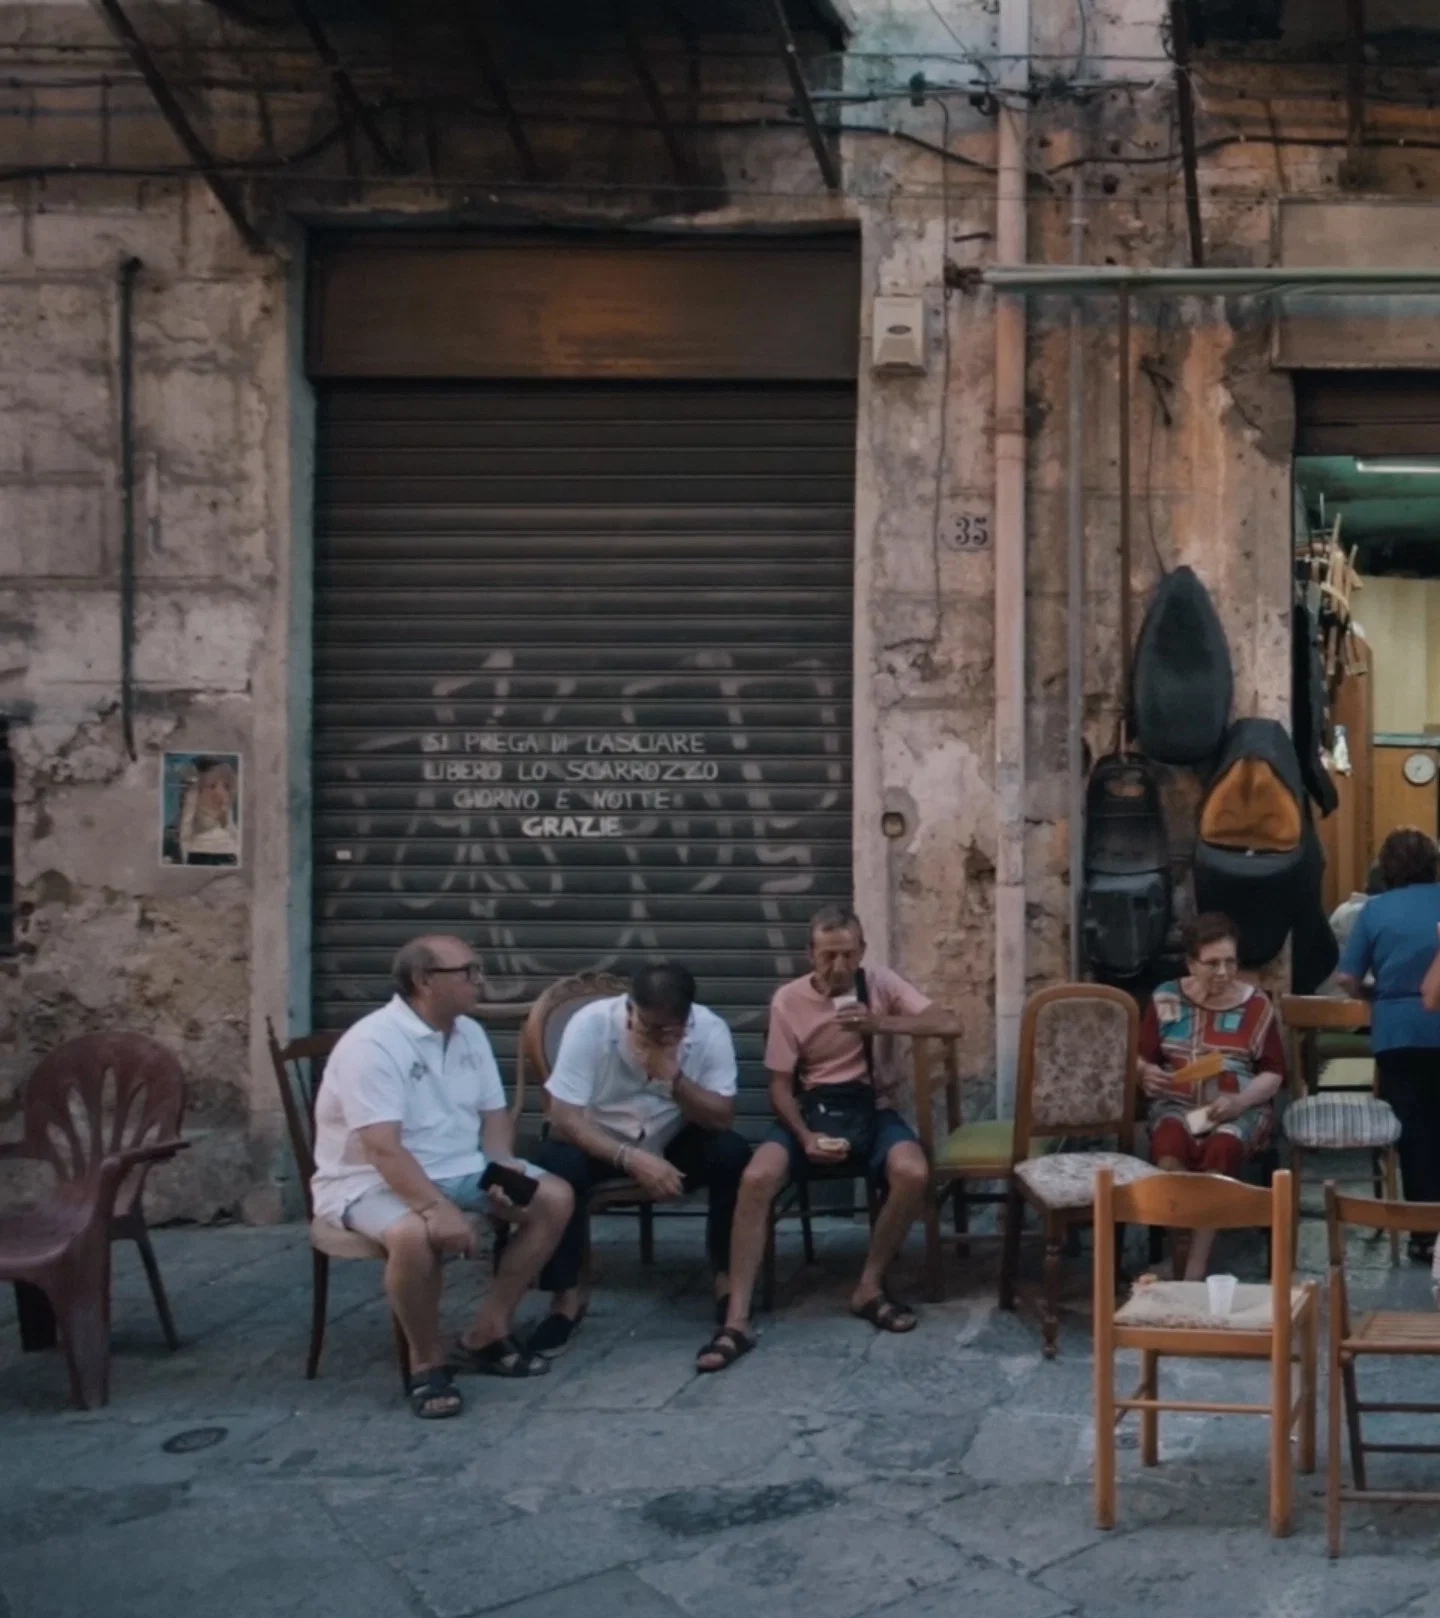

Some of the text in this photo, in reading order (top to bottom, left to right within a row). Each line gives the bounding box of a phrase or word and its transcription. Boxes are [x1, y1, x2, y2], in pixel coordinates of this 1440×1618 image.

[955, 516, 988, 545] 35
[421, 732, 706, 752] SI PREGA DI LASCIARE
[422, 760, 719, 780] LIBERO LO SCARROZZO
[452, 788, 670, 809] GIORNO E NOTTE
[521, 815, 622, 837] GRAZIE
